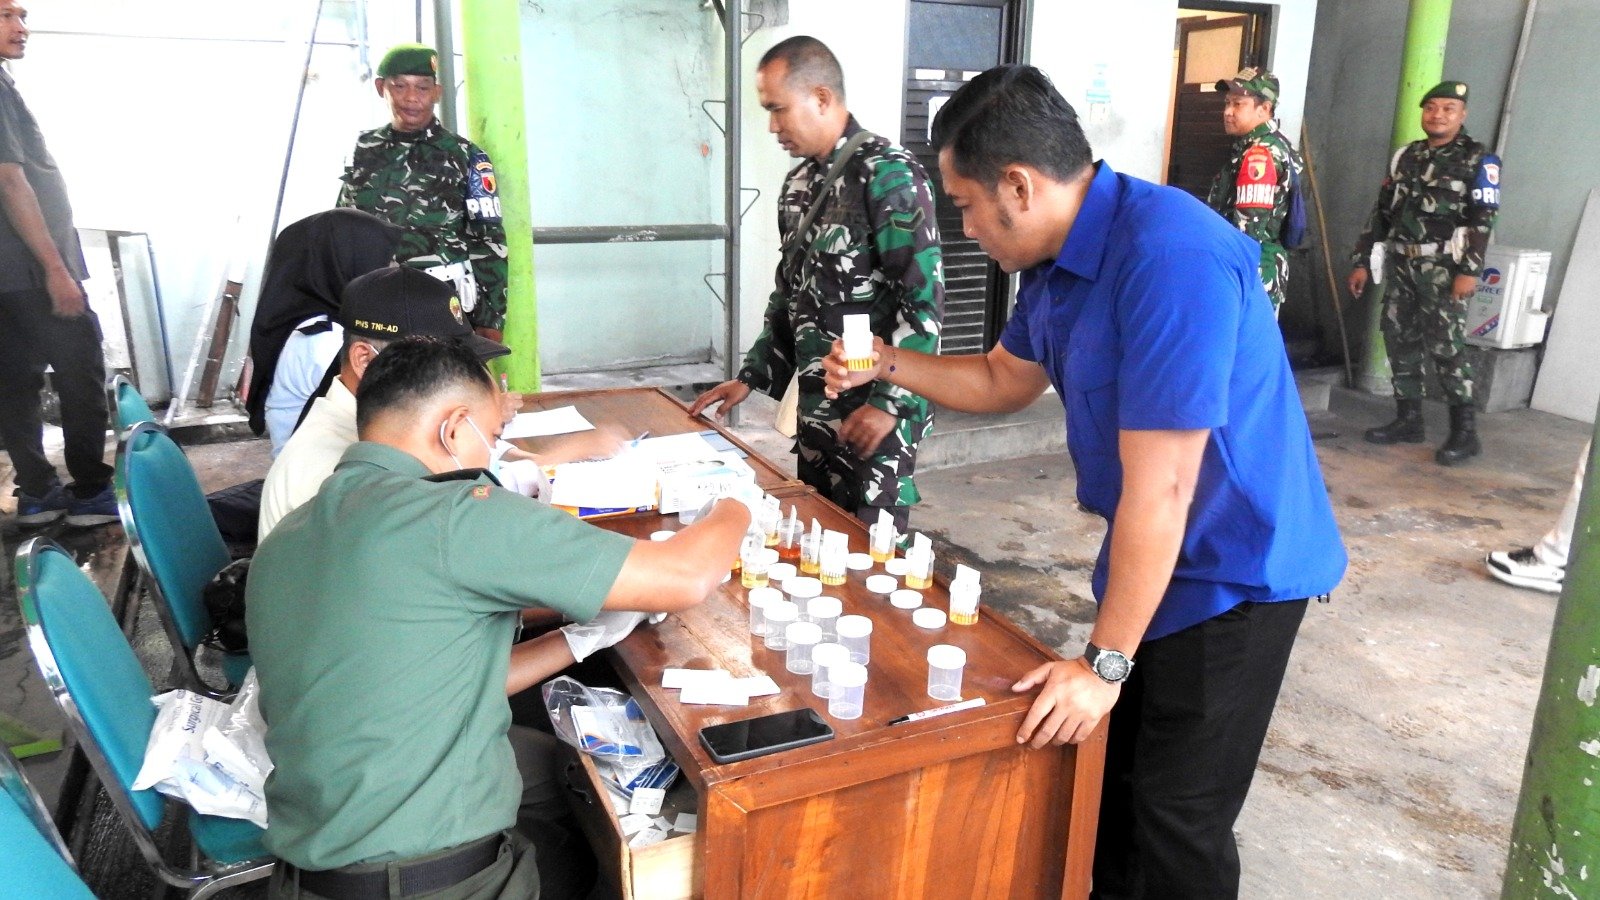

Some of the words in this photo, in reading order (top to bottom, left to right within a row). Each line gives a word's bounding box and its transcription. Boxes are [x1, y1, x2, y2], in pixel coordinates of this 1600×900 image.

[355, 319, 369, 329] PNS
[371, 322, 399, 333] TNI-AD
[182, 702, 202, 734] Surgical
